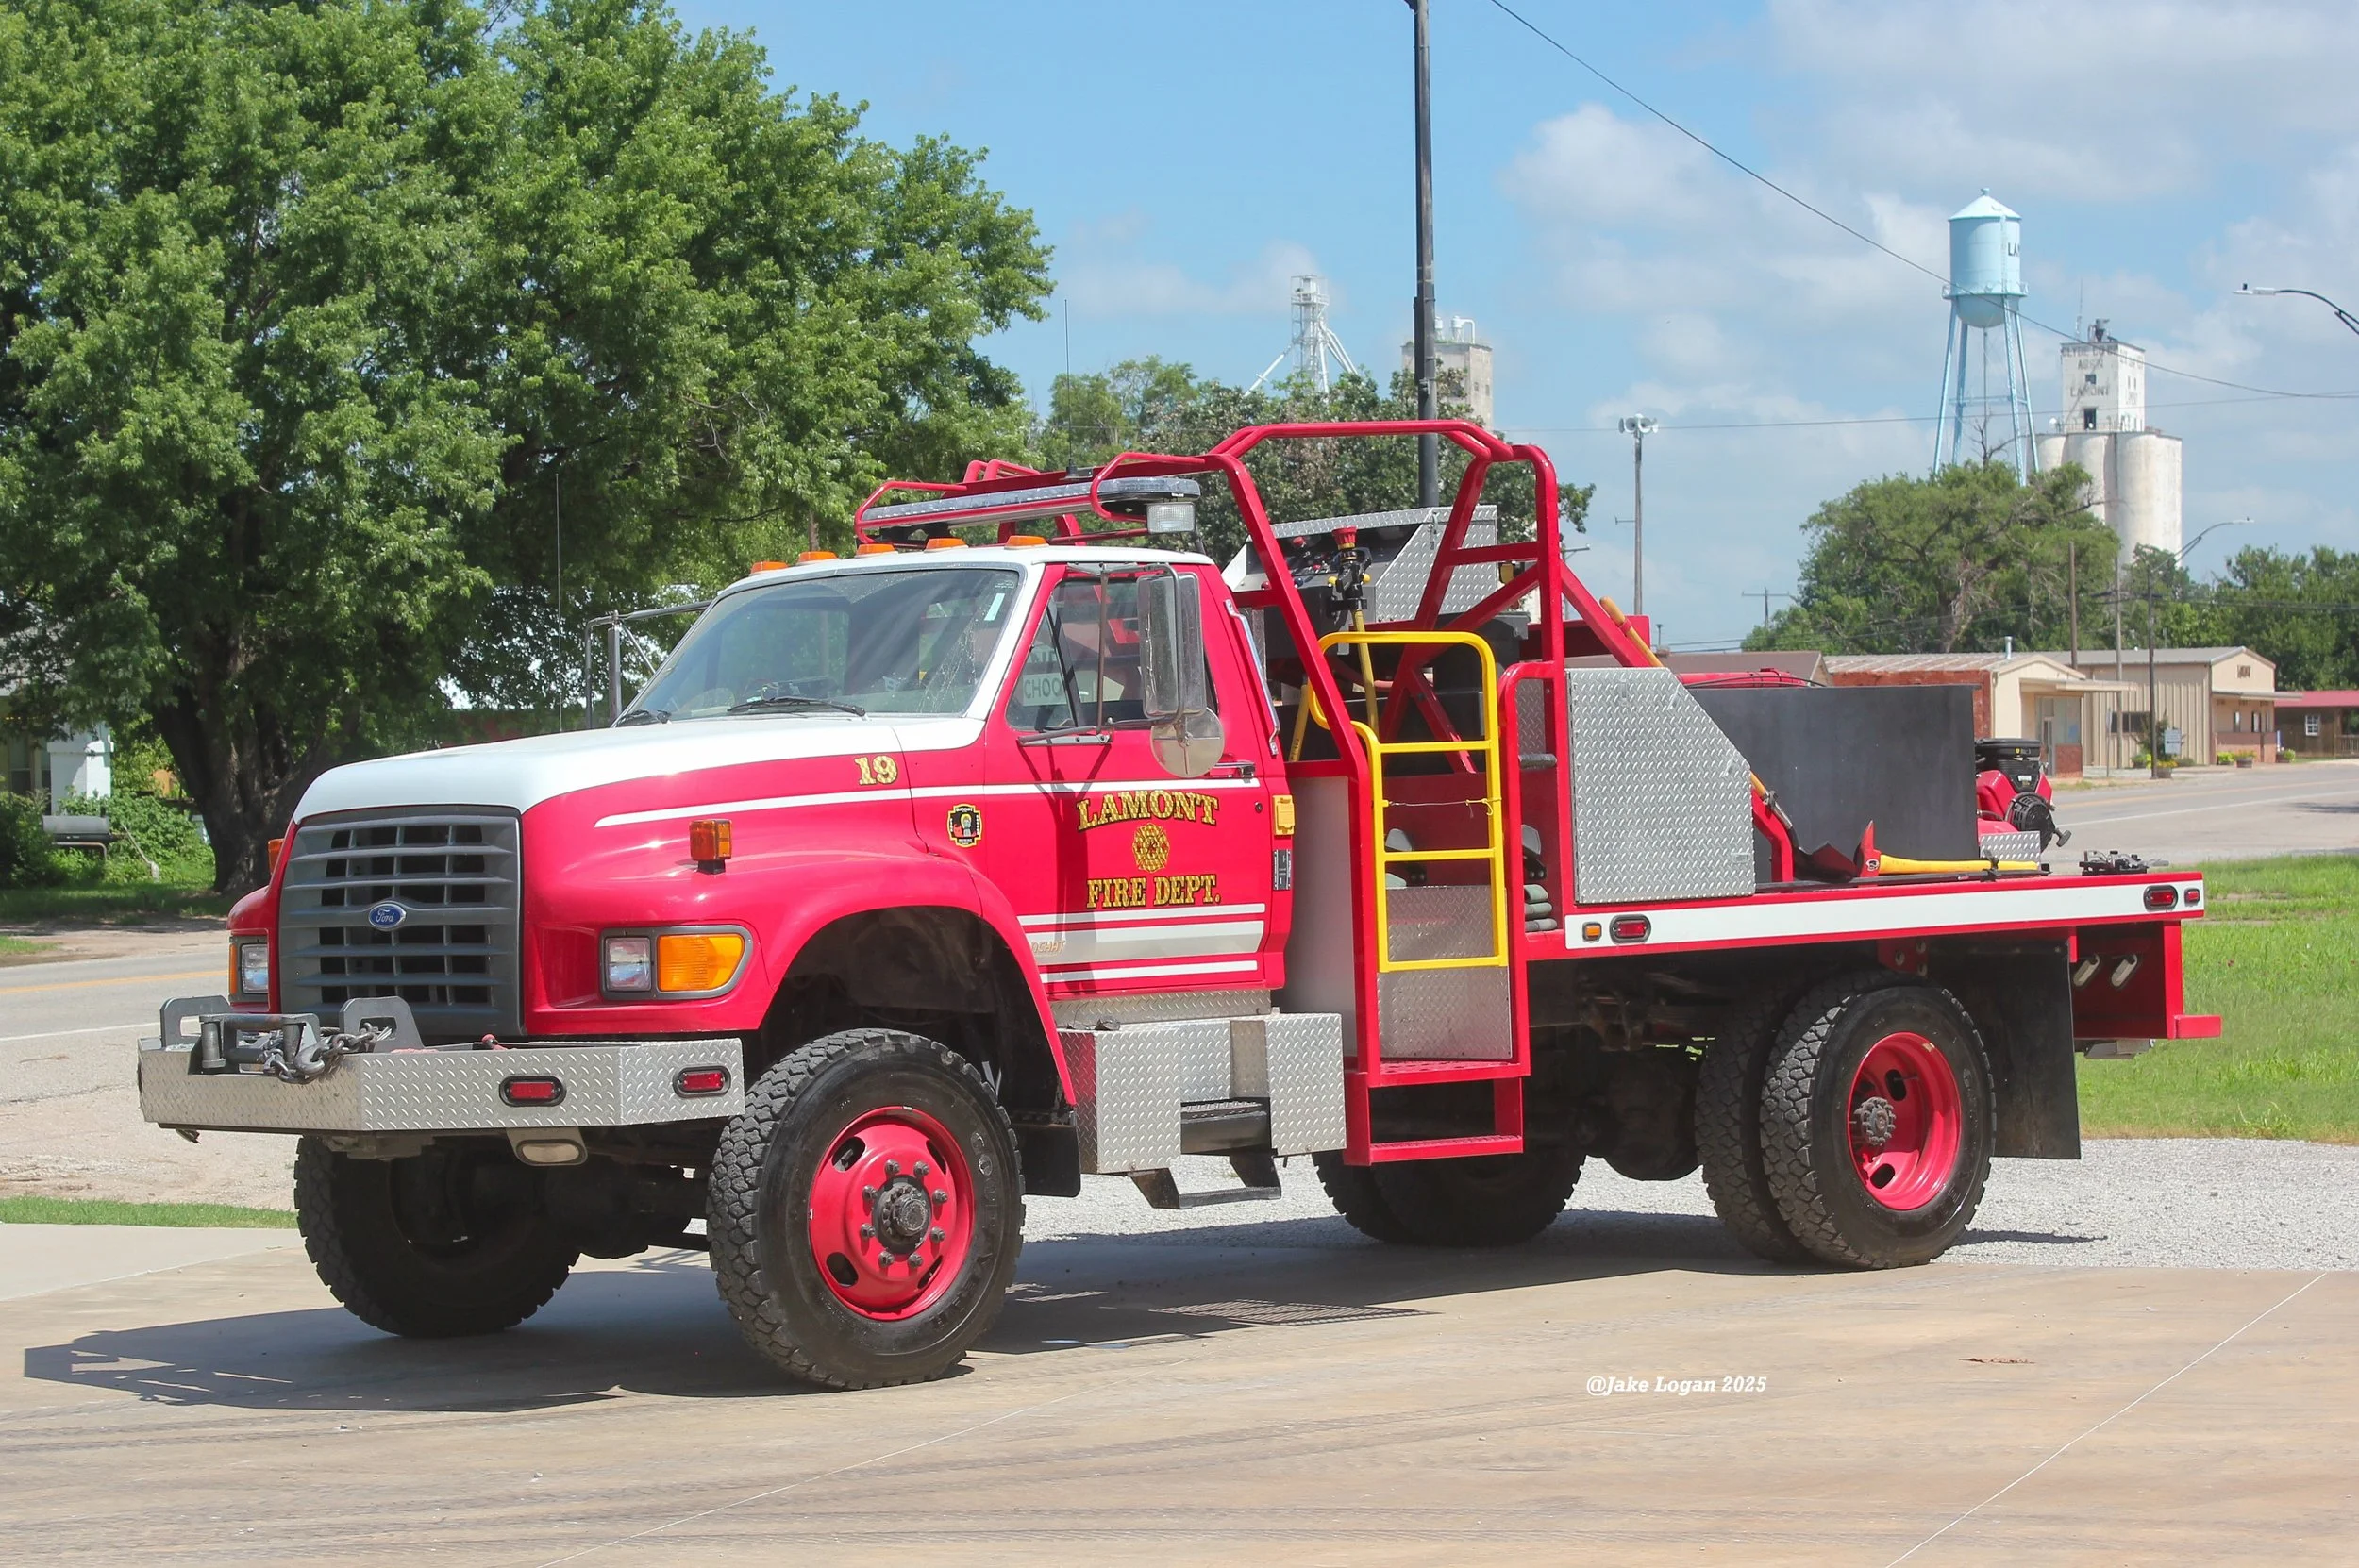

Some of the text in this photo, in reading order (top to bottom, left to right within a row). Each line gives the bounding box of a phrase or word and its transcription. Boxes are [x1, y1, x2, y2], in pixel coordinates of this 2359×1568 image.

[854, 756, 897, 785] 19
[1077, 789, 1219, 832] LAMONT
[1087, 875, 1221, 909] FIRE DEPT.
[376, 909, 395, 923] Ford
